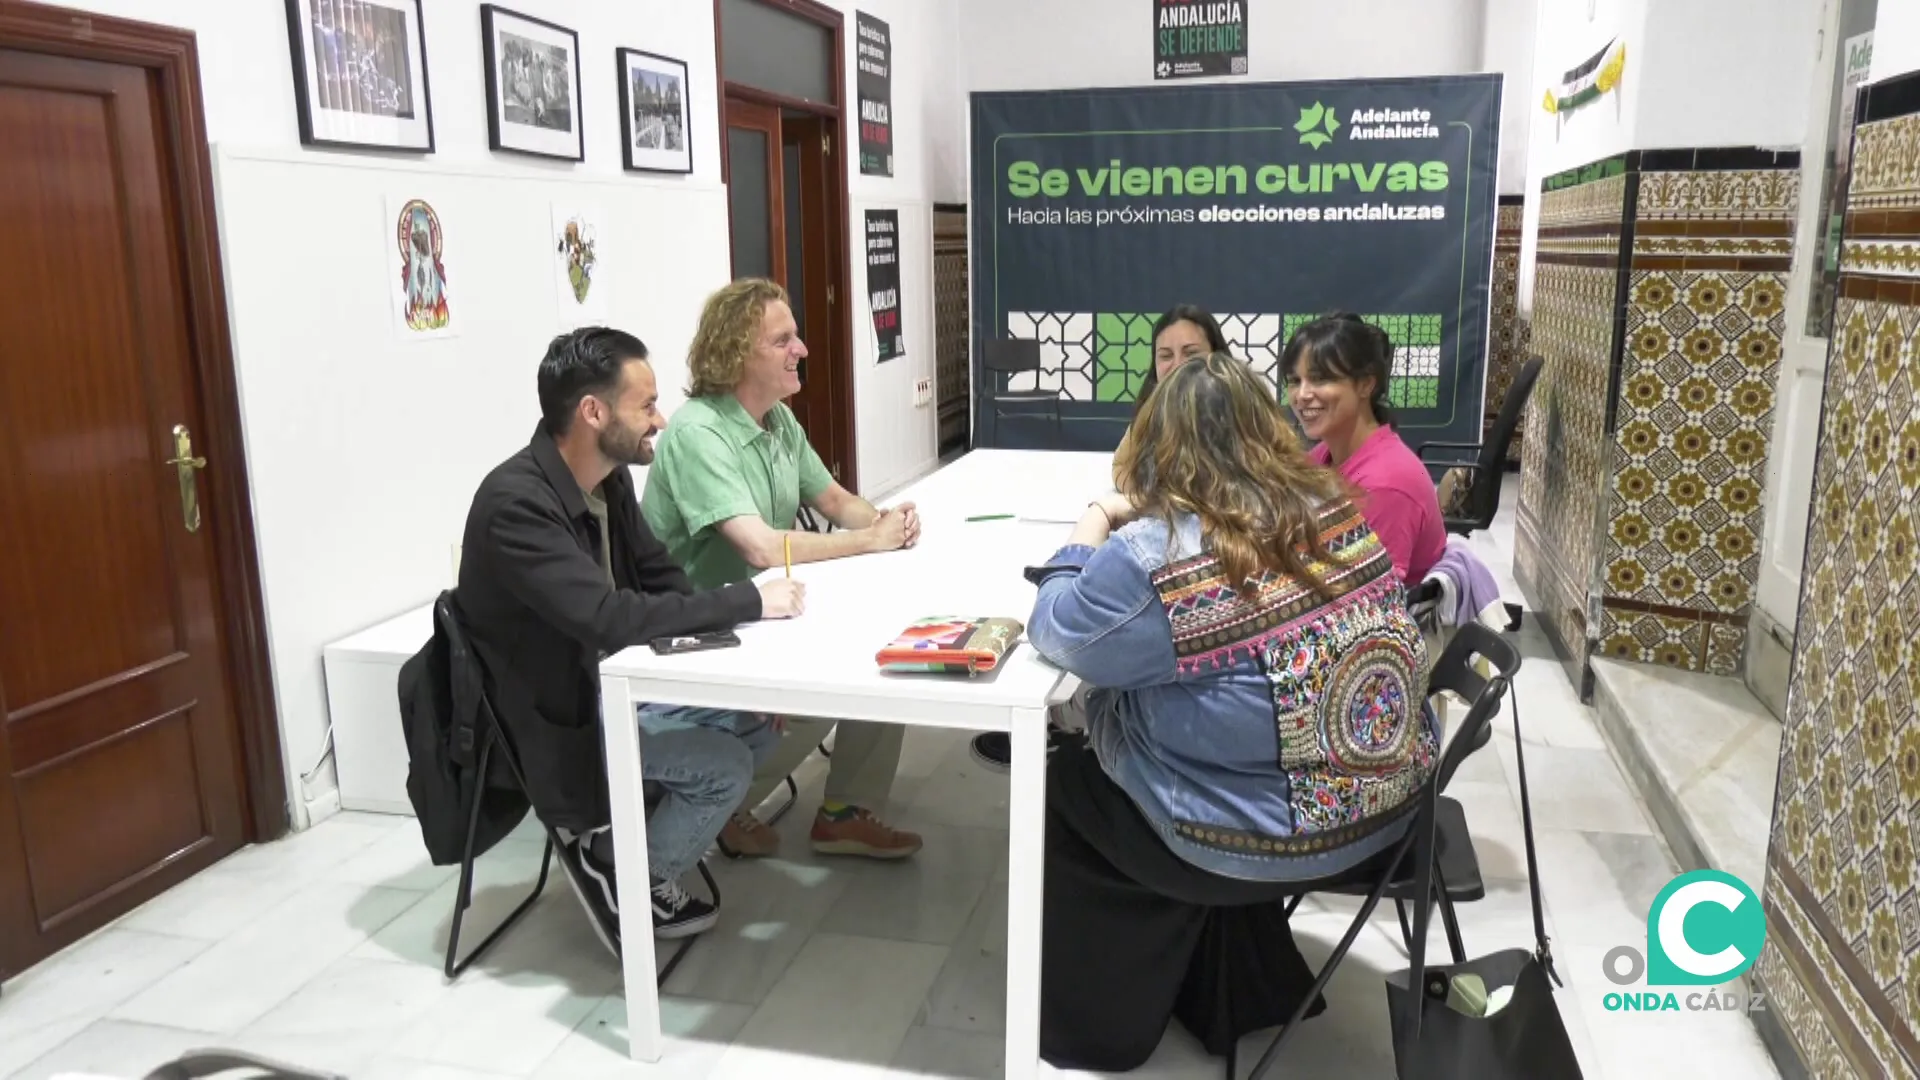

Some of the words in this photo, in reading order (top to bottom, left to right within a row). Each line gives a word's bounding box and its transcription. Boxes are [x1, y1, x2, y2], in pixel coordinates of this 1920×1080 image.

[1159, 0, 1242, 28] ANDALUCÍA
[1159, 28, 1176, 56] SE
[1180, 24, 1242, 54] DEFIENDE
[862, 99, 888, 124] ANDALUCÍA
[1351, 108, 1431, 124] Adelante
[1350, 123, 1439, 140] Andalucía
[1007, 160, 1069, 198] Se
[1076, 159, 1247, 196] vienen
[1255, 160, 1449, 194] curvas
[1008, 207, 1061, 224] Hacia
[1066, 206, 1092, 224] las
[1096, 205, 1195, 228] próximas
[1198, 204, 1320, 222] elecciones
[1323, 203, 1445, 220] andaluzas
[872, 286, 897, 311] ANDALUCÍA
